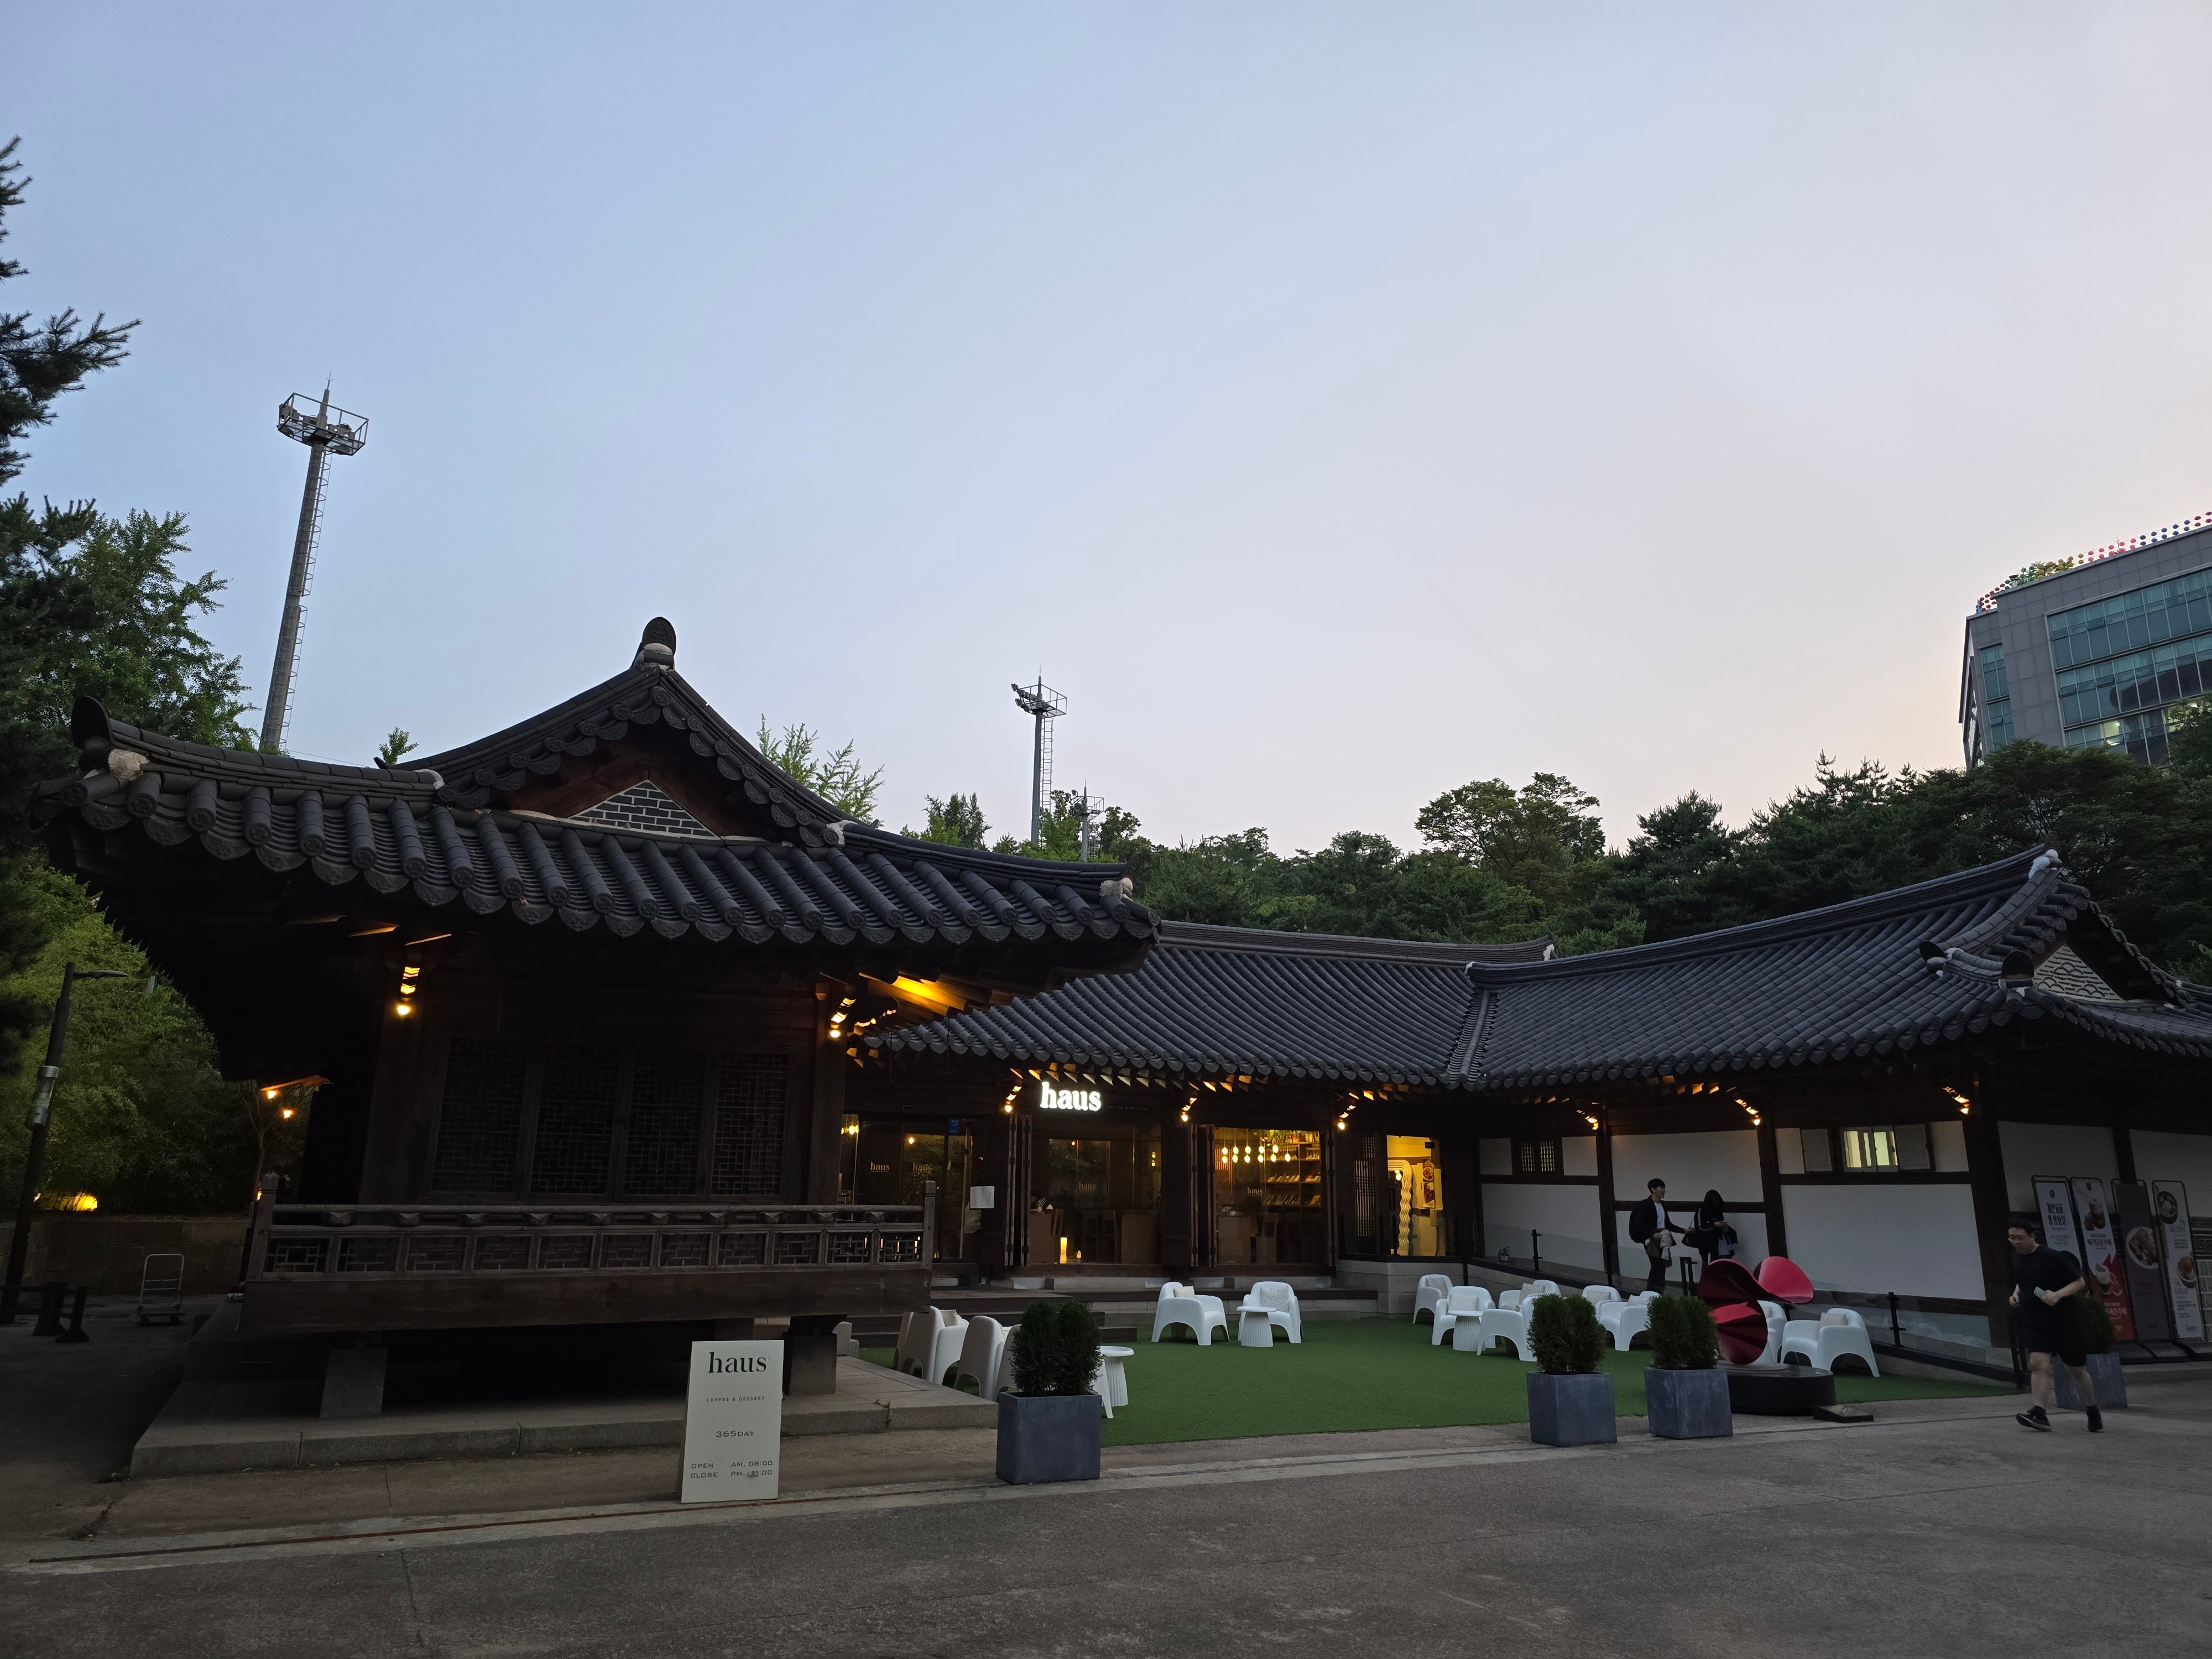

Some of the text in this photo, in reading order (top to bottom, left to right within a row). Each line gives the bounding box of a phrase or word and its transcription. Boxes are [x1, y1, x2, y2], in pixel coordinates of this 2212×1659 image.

[1040, 1081, 1102, 1112] haus
[870, 1162, 890, 1170] haus
[1079, 1181, 1096, 1190] haus
[707, 1352, 767, 1373] haus
